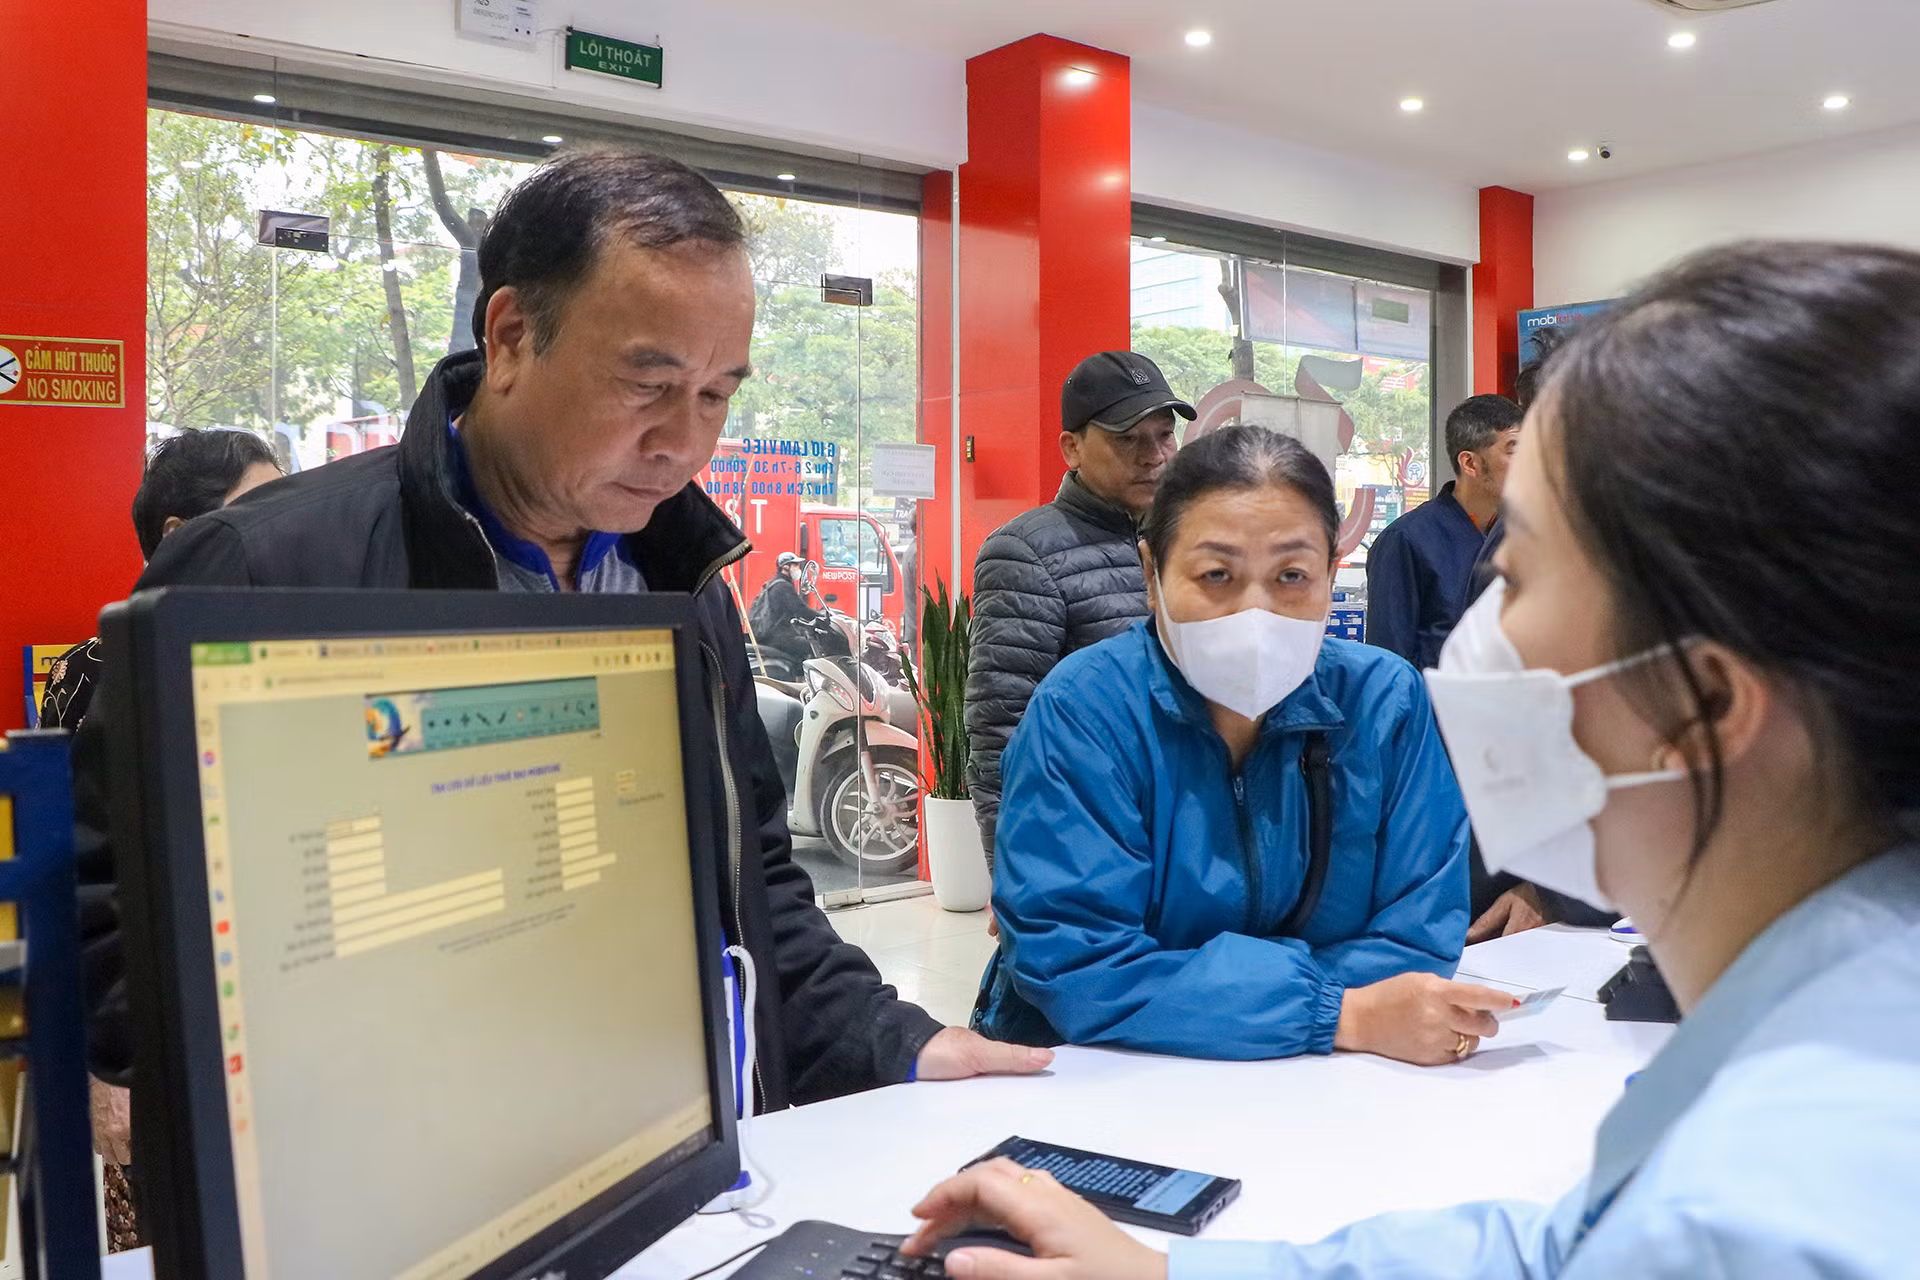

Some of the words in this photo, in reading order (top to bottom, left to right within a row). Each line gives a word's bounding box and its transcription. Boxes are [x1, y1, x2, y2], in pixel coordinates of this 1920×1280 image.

[598, 61, 632, 73] EXIT
[605, 46, 652, 68] THOÁT
[55, 347, 77, 371] HÚT
[79, 346, 116, 373] THUỐC
[27, 378, 48, 399] NO
[51, 379, 116, 401] SMOKING
[822, 571, 857, 581] NEWPOST
